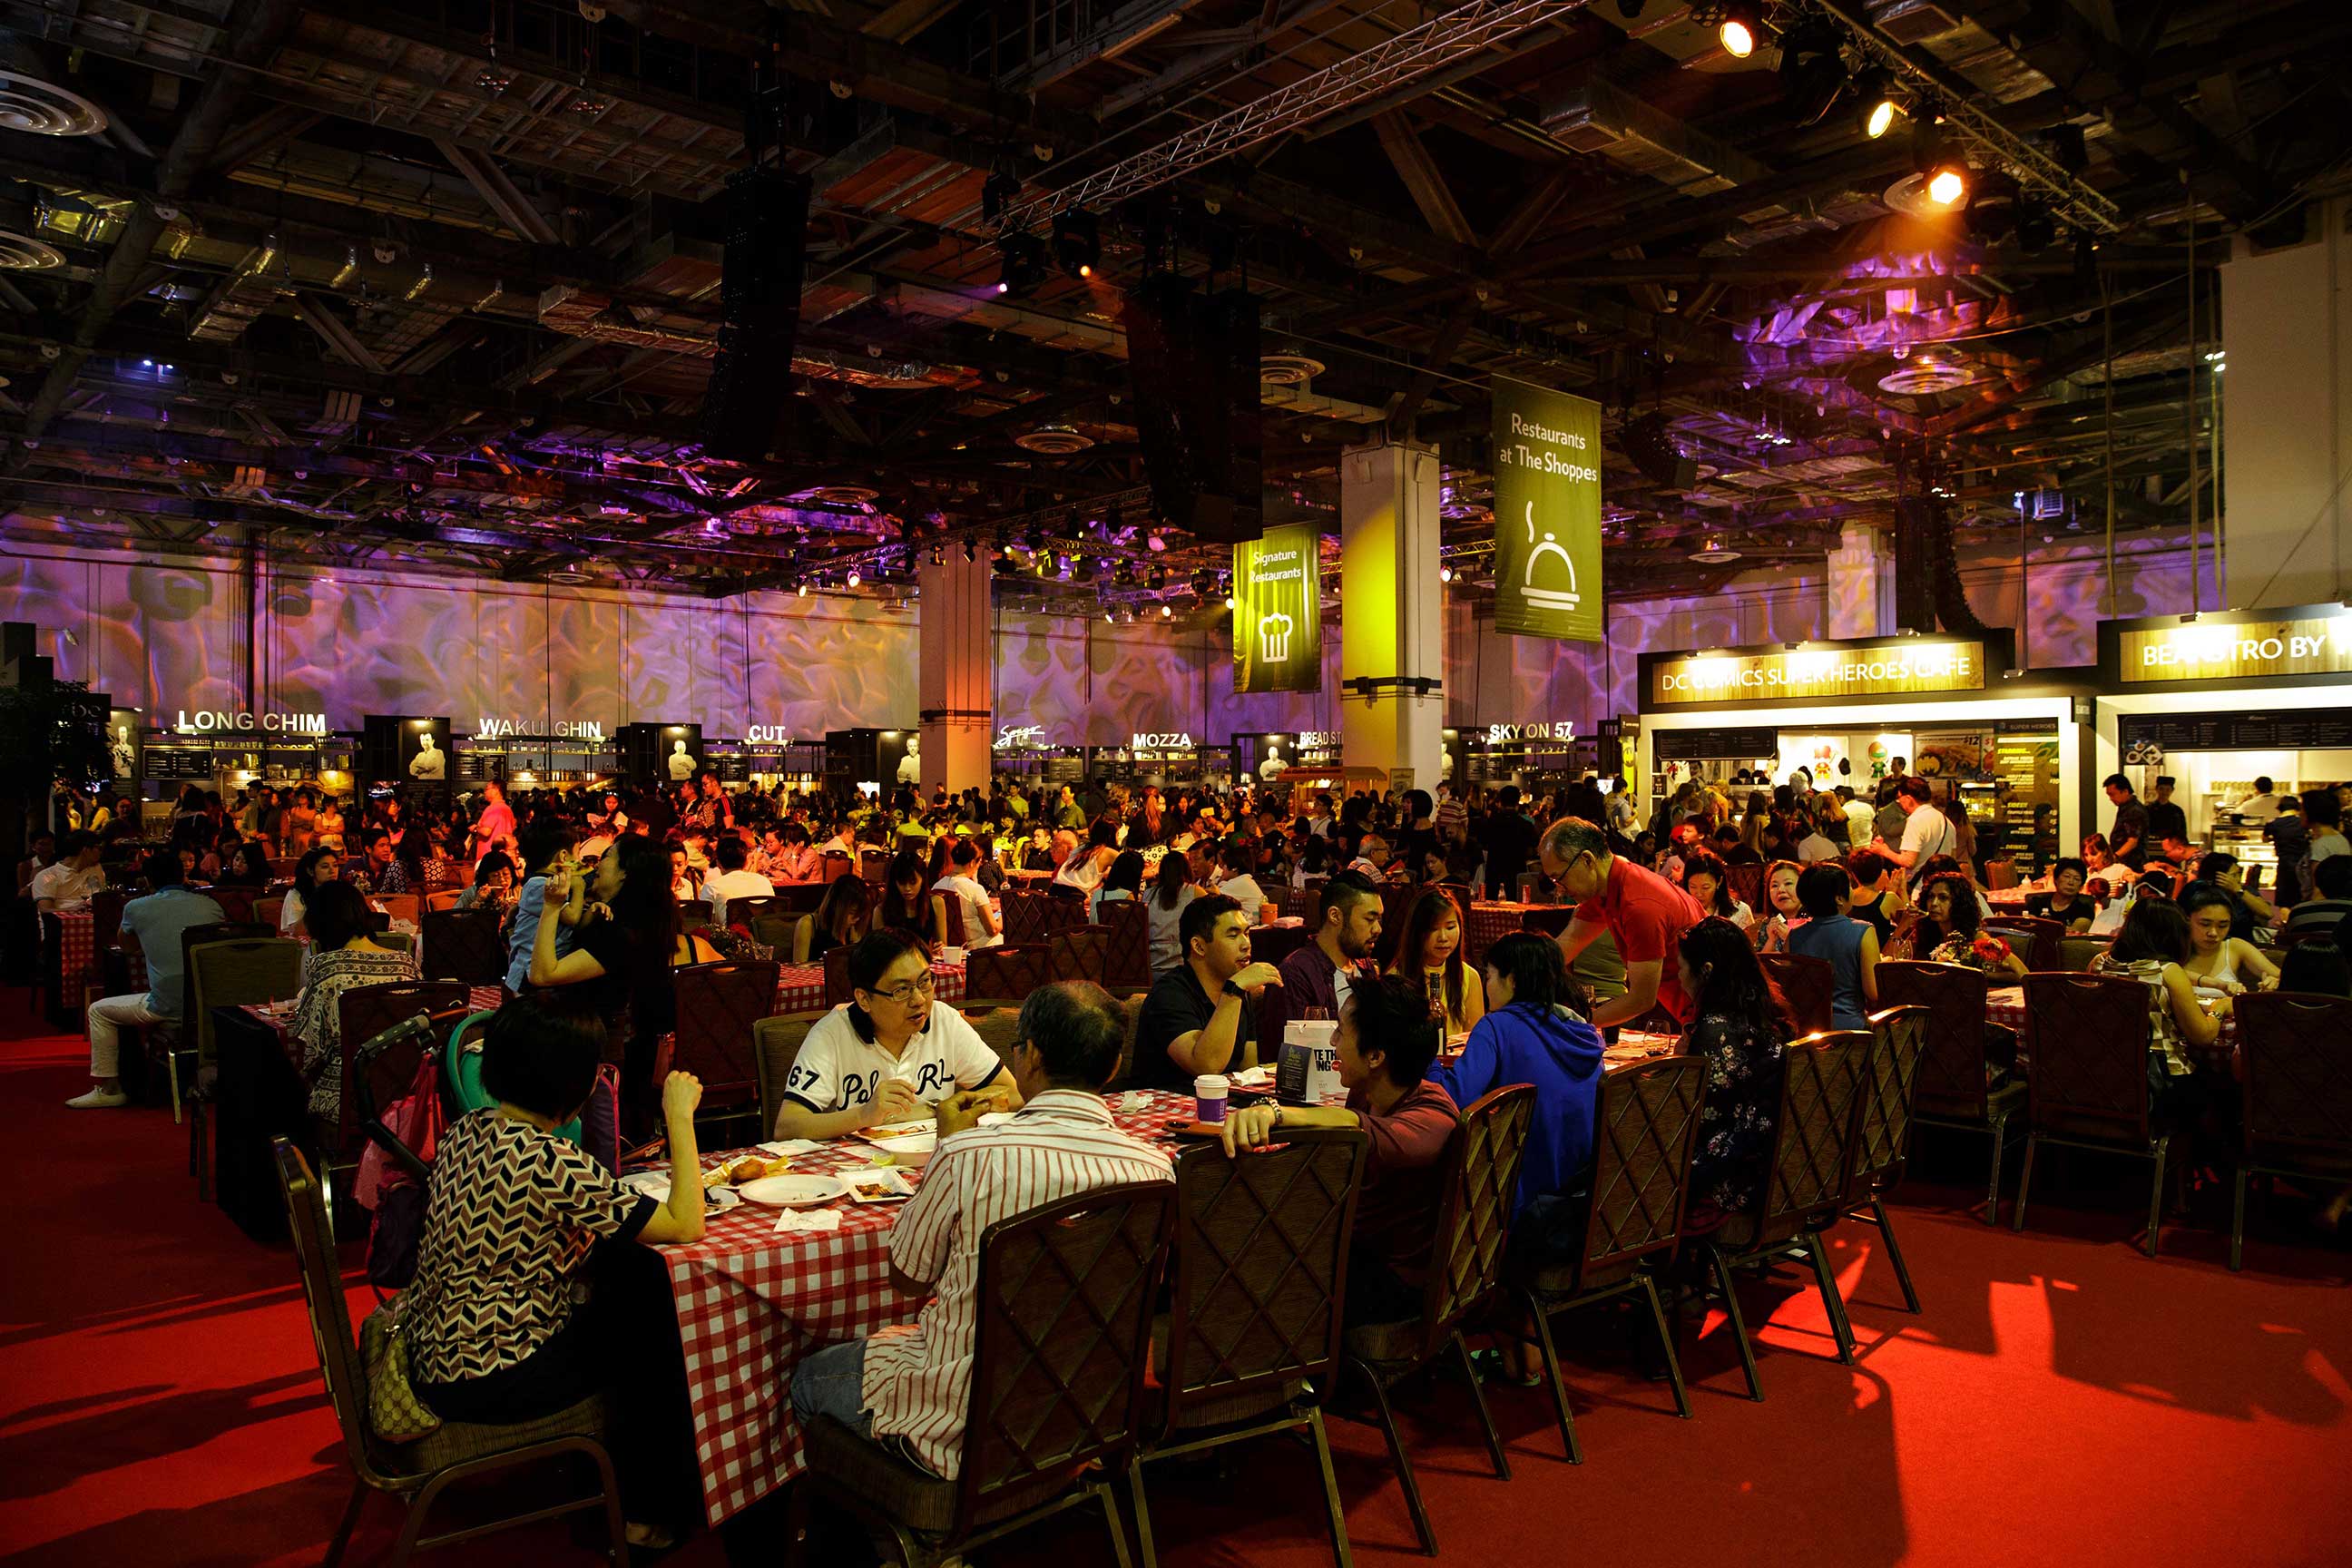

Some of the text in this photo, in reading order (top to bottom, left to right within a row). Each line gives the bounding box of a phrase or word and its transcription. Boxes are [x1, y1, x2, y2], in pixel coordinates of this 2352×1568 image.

[1512, 413, 1586, 450] Restaurants
[1500, 445, 1598, 485] at The Shoppes
[1253, 549, 1298, 566] Signature
[1250, 566, 1302, 583] Restaurants
[2143, 637, 2284, 666] BETRO
[2289, 635, 2327, 659] BY
[1663, 673, 1688, 691] DC
[1830, 660, 1909, 681] HEROES
[1914, 657, 1970, 677] CAFE
[178, 710, 327, 731] LONG CHIM
[479, 718, 602, 737] WAKU GHIN
[749, 725, 786, 741] CUT
[1132, 733, 1191, 747] MOZZA
[1299, 731, 1329, 745] BREAD
[1489, 721, 1573, 740] SKY ON 57
[1964, 736, 1980, 745] $12
[788, 1066, 820, 1091] 67
[837, 1058, 955, 1112] Pol RL
